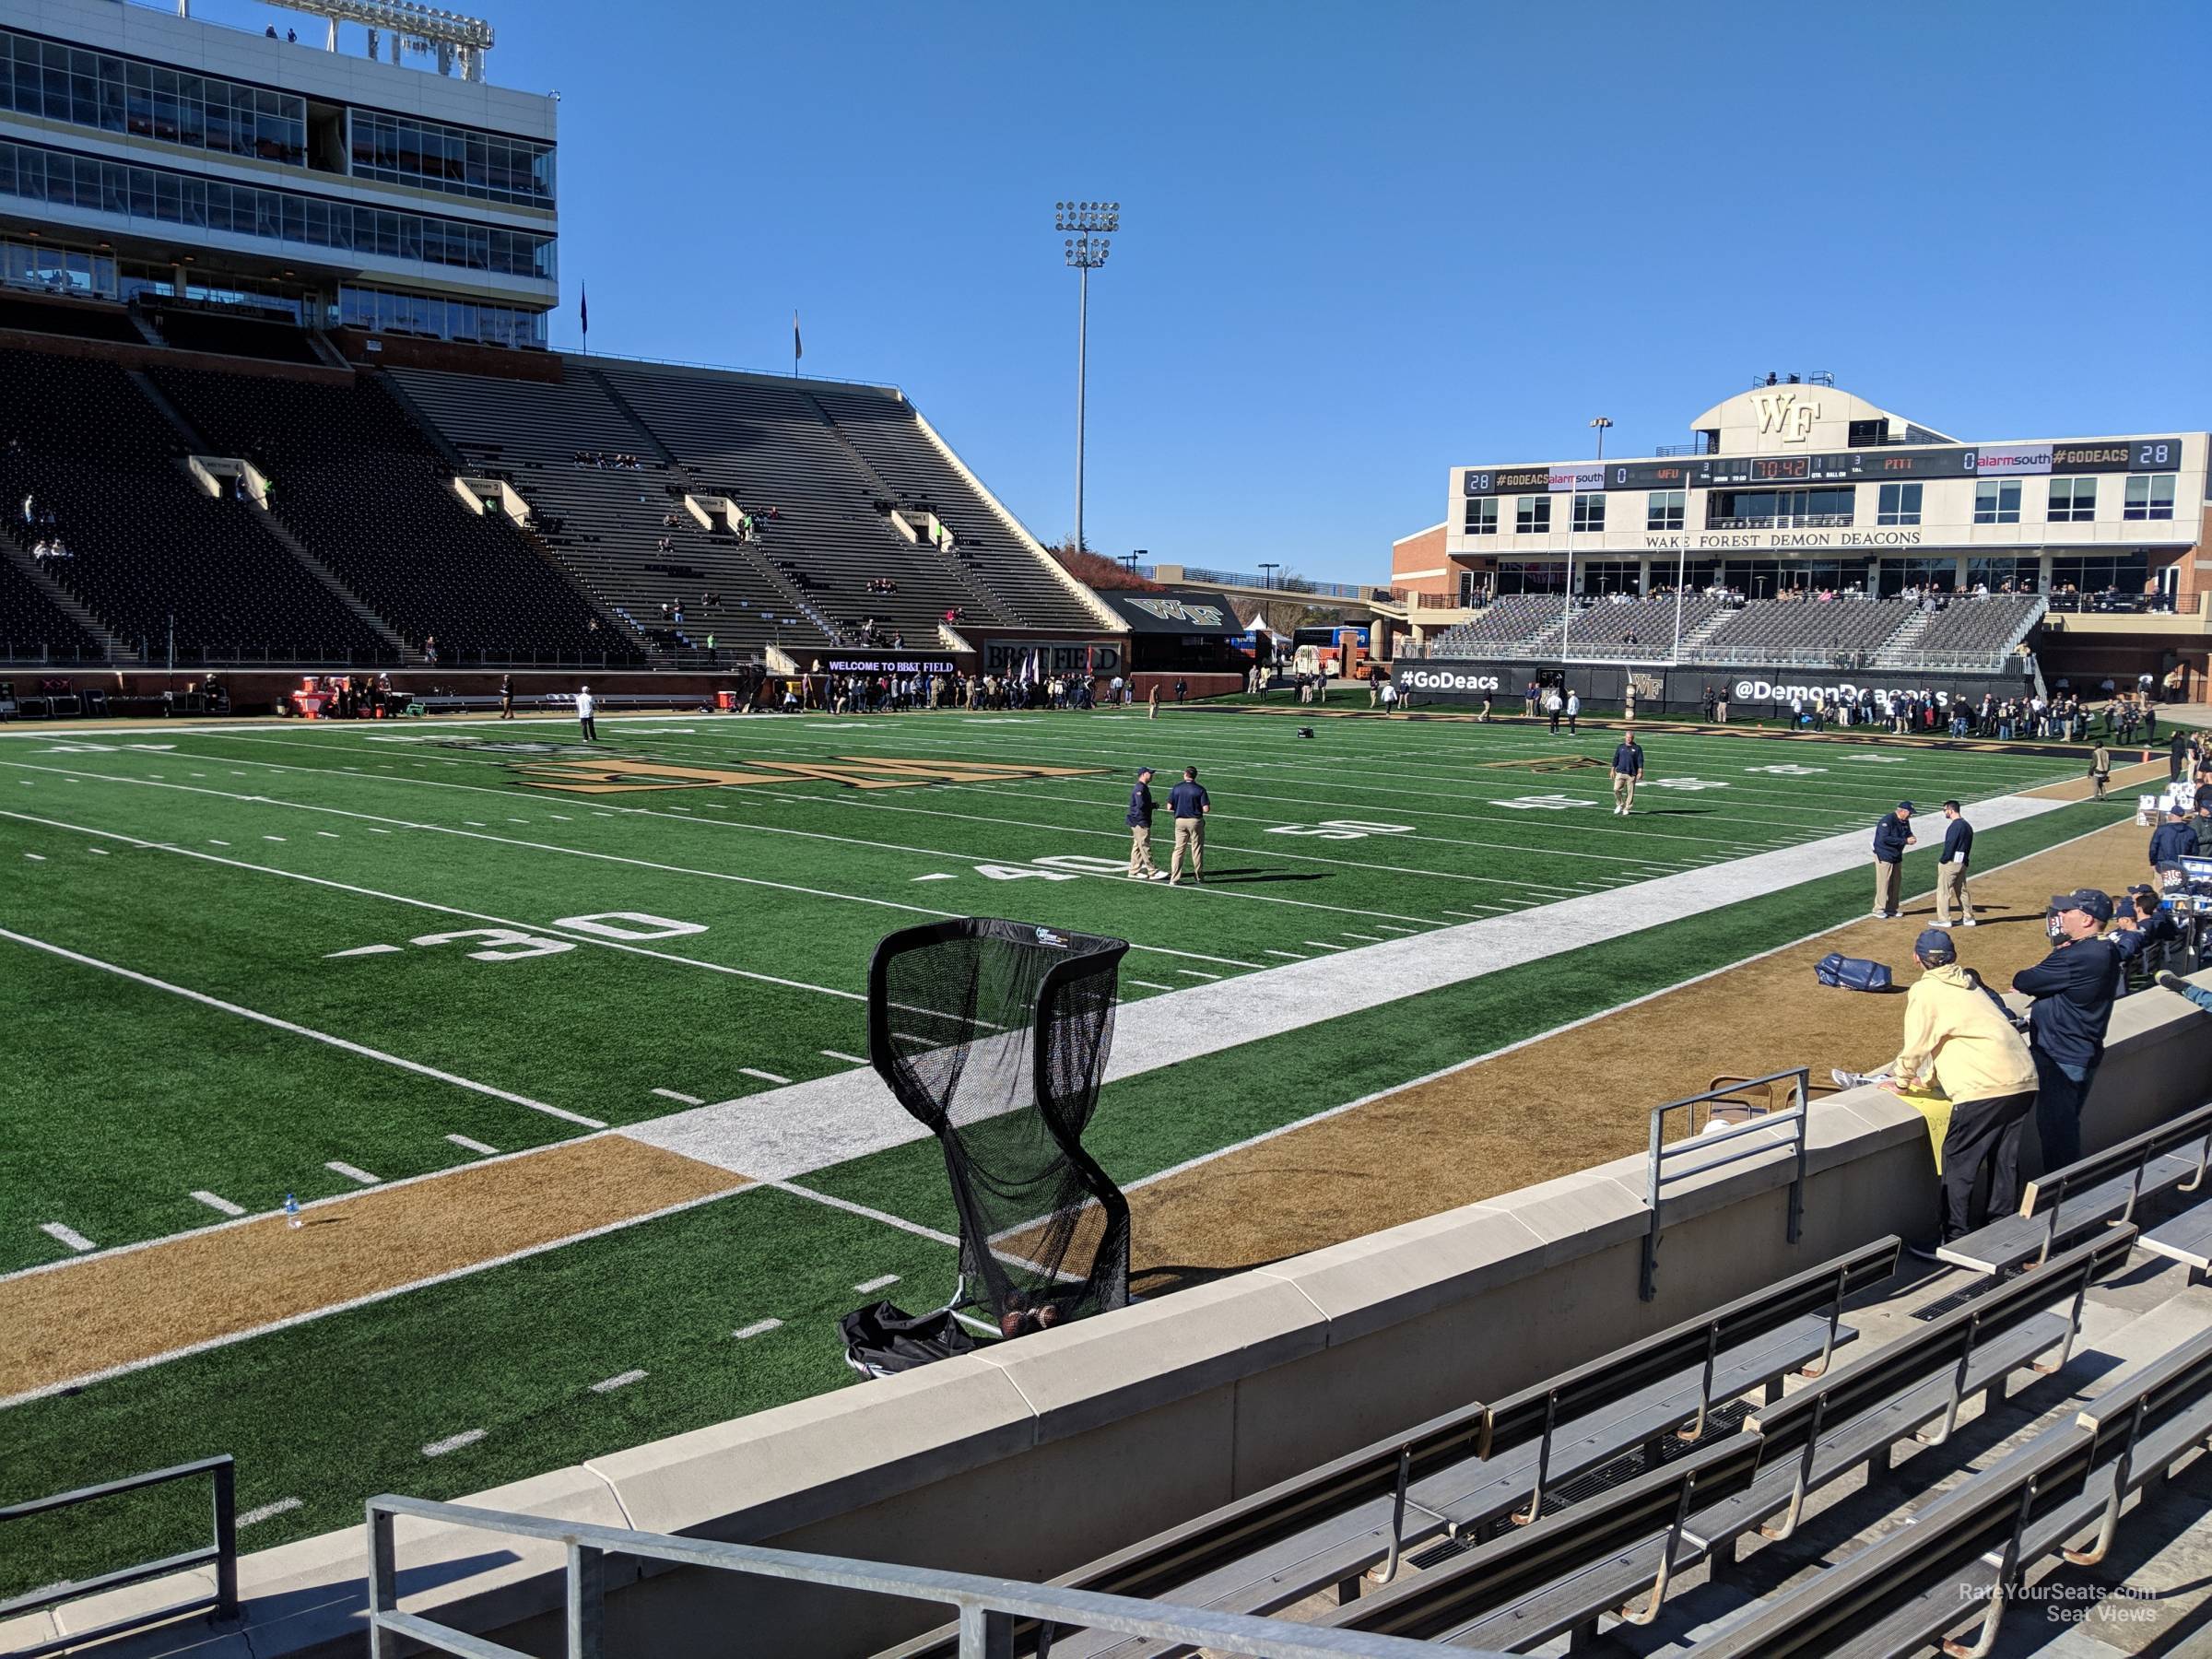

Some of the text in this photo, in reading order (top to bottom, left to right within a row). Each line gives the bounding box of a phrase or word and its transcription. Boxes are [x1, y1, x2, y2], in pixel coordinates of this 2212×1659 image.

[1750, 393, 1821, 442] WF
[1977, 453, 2051, 466] alarmsouth
[2053, 449, 2129, 464] #GODEACS
[2140, 445, 2169, 464] 28
[1470, 474, 1488, 489] 28
[1496, 473, 1548, 487] #GODEACS
[1646, 532, 1921, 548] WAKE FOREST DEMON DEACONS
[1124, 597, 1225, 627] WF
[830, 661, 954, 673] WELCOME TO BB&T FIELD
[1400, 670, 1499, 690] #GoDeacs
[1632, 673, 1664, 699] WF
[1264, 819, 1417, 840] 50
[973, 856, 1147, 881] 40
[408, 912, 710, 961] 30
